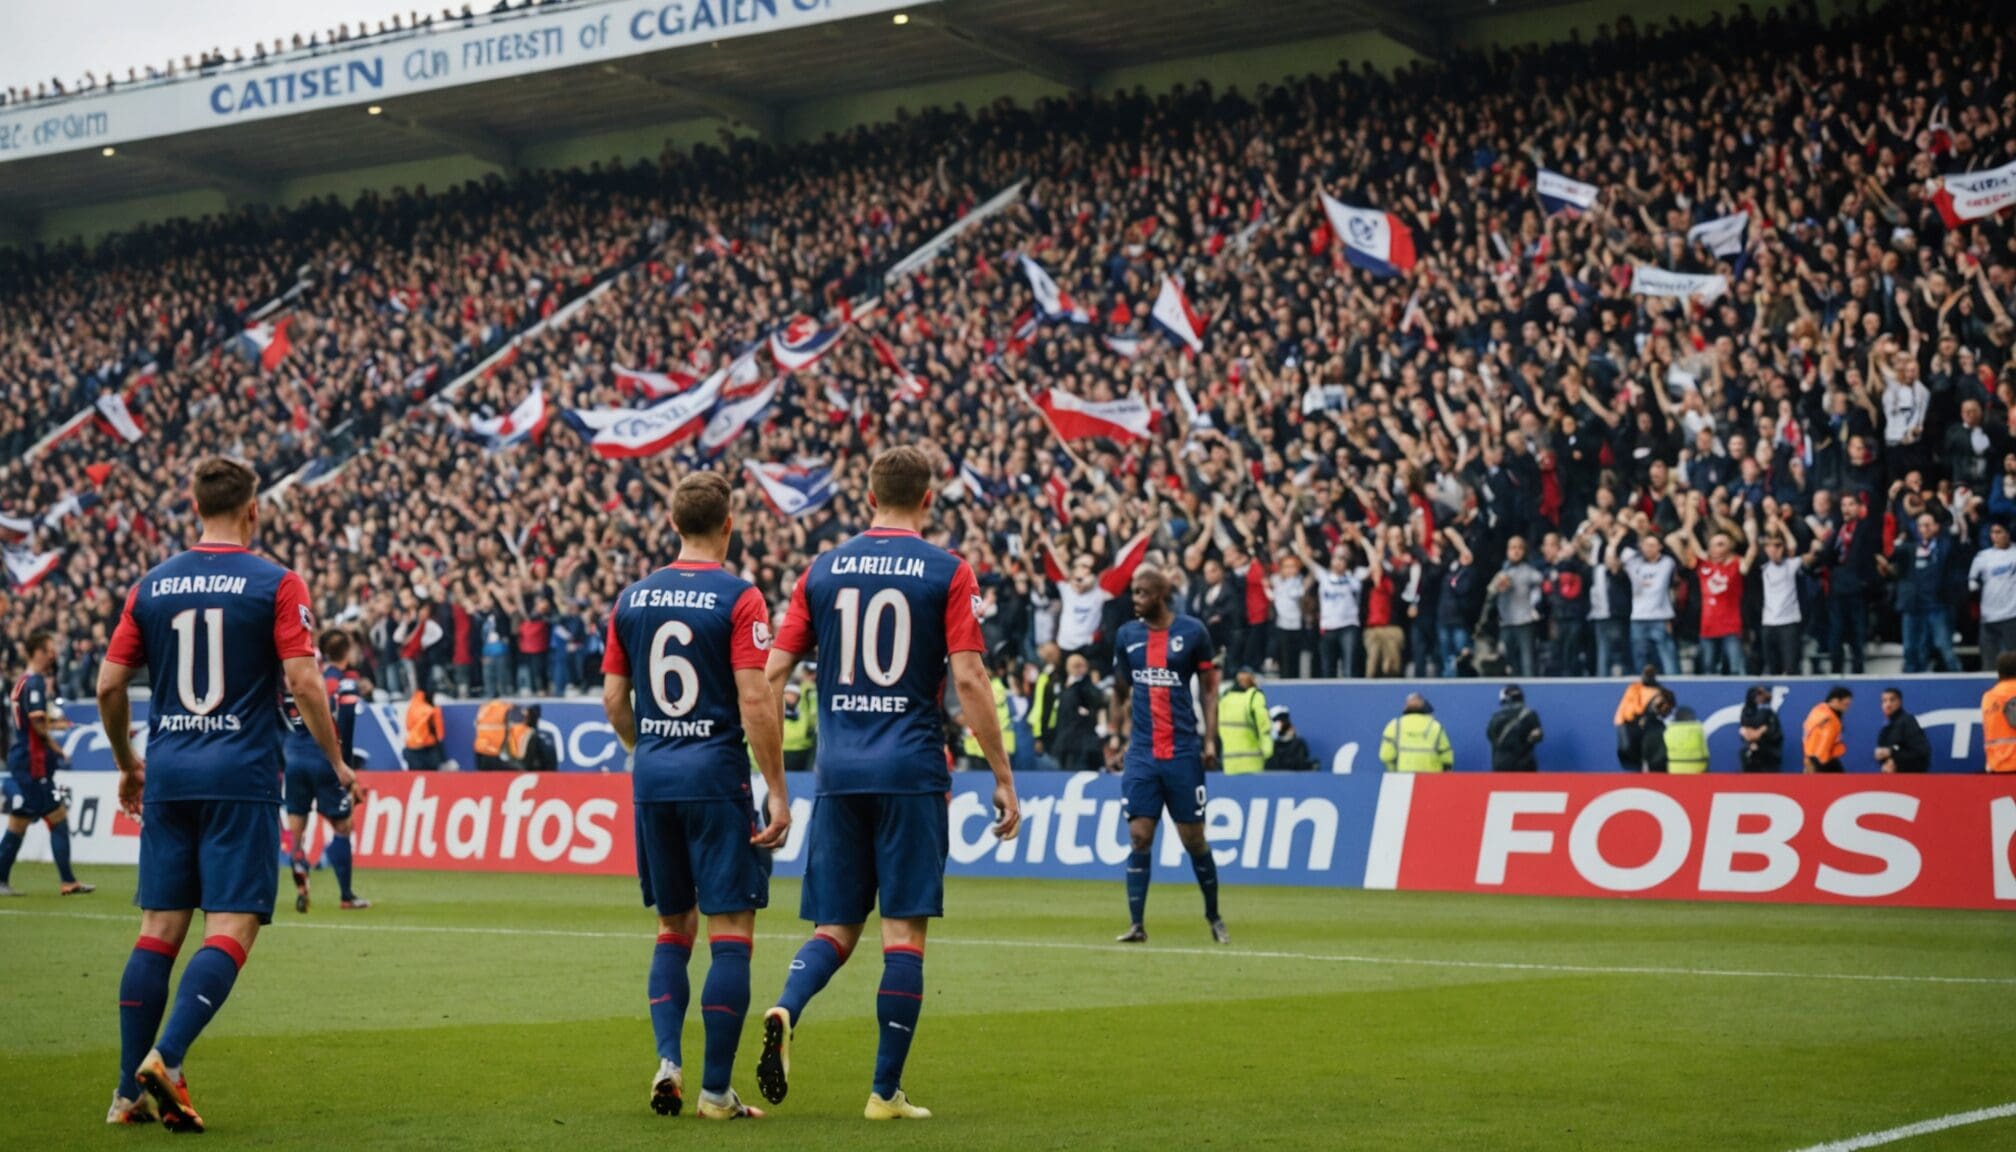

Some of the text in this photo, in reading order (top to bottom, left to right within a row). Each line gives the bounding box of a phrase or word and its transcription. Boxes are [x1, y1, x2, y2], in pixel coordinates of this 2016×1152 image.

[649, 620, 700, 718] 6
[834, 588, 912, 687] 10
[1475, 788, 1923, 898] FOBS
